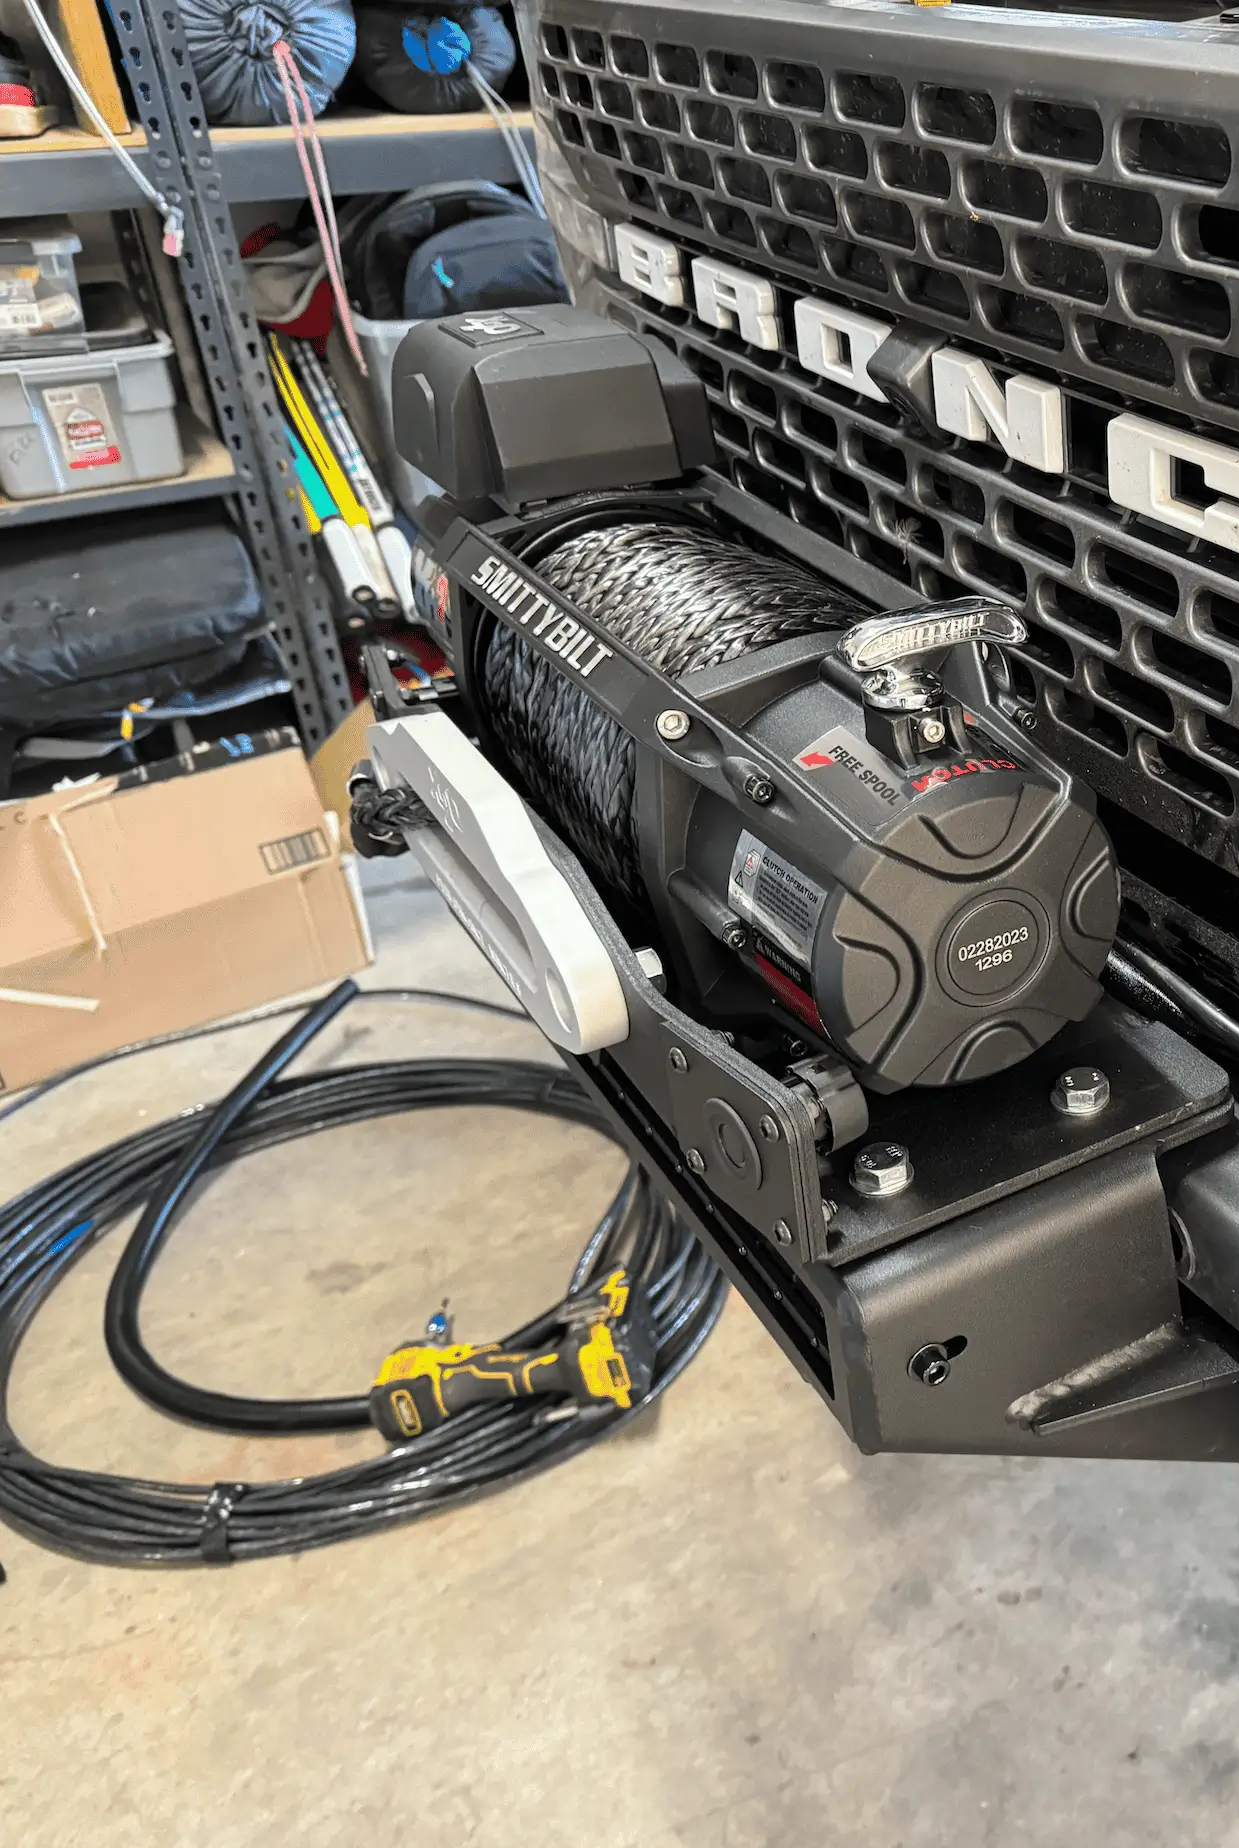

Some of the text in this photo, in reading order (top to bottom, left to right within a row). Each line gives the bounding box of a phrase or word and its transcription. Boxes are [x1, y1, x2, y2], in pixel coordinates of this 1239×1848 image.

[470, 555, 614, 678] SMITTYBILT
[877, 611, 990, 650] SMITTYBILT
[828, 745, 901, 807] FREE SPOOL
[762, 856, 818, 903] CLUTCH OPERATION
[958, 926, 1029, 962] 02282023
[975, 949, 1013, 972] 1296
